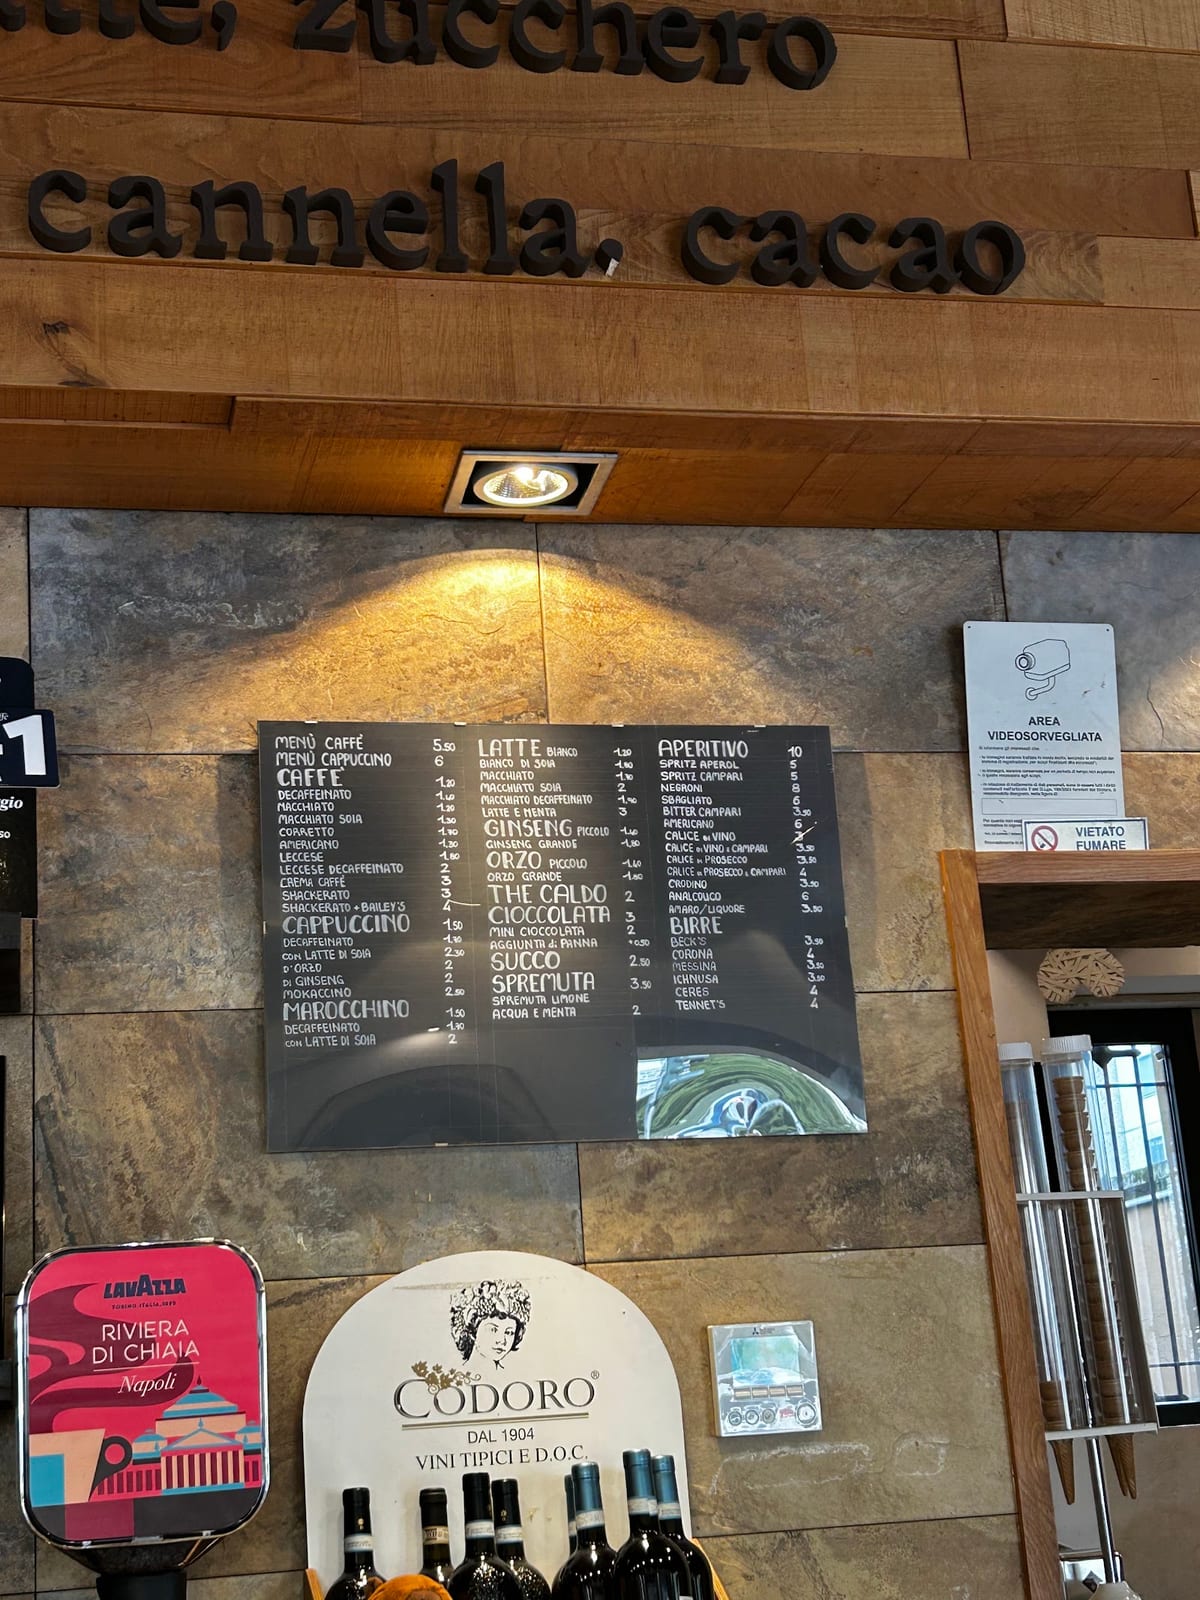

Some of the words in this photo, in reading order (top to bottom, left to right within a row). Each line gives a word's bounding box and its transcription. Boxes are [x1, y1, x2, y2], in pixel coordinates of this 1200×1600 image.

[293, 0, 838, 90] zucchero
[680, 206, 1026, 294] cacao
[1028, 716, 1061, 726] AREA
[275, 733, 316, 750] MENÙ
[987, 730, 1102, 742] VIDEOSORVEGLIATA
[478, 738, 542, 757] LATTE
[547, 747, 578, 757] BIANCO
[658, 738, 749, 759] APERITIVO
[787, 746, 803, 758] 10
[275, 751, 316, 766] MENÙ
[321, 752, 392, 767] CAPPUCCINO
[434, 755, 444, 767] 6
[479, 759, 514, 768] BIANCO
[520, 759, 530, 768] DI
[534, 759, 556, 768] SOIA
[659, 759, 697, 769] SPRITZ
[700, 760, 740, 769] APEROL
[790, 759, 797, 769] 5
[480, 771, 534, 780] MACCHIATO
[660, 771, 697, 781] SPRITZ
[700, 772, 743, 781] CAMPARI
[790, 771, 798, 781] 5
[480, 783, 535, 792] MACCHIATO
[539, 782, 562, 792] SOIA
[617, 782, 627, 792] 2
[661, 784, 703, 793] NEGRONI
[791, 783, 800, 793] 8
[278, 789, 352, 800] DECAFFEINATO
[481, 795, 531, 804] MACCHIATO
[533, 794, 593, 805] DECAFFEINATO
[661, 795, 713, 805] SBAGLIATO
[792, 795, 801, 805] 6
[277, 801, 335, 812] MACCHIATO
[482, 807, 509, 817] LATTE
[514, 808, 521, 817] E
[523, 807, 557, 817] MENTA
[618, 807, 628, 816] 3
[663, 806, 696, 816] BITTER
[698, 807, 742, 817] CAMPARI
[278, 814, 334, 824] MACCHIATO
[339, 814, 363, 824] SOIA
[663, 819, 714, 828] AMERICANO
[794, 818, 803, 828] 6
[278, 827, 335, 837] CORRETTO
[483, 818, 573, 837] GINSENG
[576, 826, 610, 837] PICCOLO
[1075, 826, 1125, 838] VIETATO
[665, 831, 700, 841] CALICE
[712, 831, 736, 841] VINO
[279, 839, 339, 850] AMERICANO
[485, 840, 532, 849] GINSENG
[538, 838, 578, 849] GRANDE
[665, 843, 694, 852] CALICE
[703, 844, 724, 853] VINO
[731, 844, 768, 853] CAMPARI
[1076, 839, 1127, 850] FUMARE
[279, 852, 324, 862] LECCESE
[486, 850, 542, 869] ORZO
[549, 858, 588, 870] PICCOLO
[666, 855, 694, 864] CALICE
[704, 855, 748, 864] PROSECCO
[279, 864, 324, 875] LECCESE
[329, 863, 404, 874] DECAFFEINATO
[440, 863, 450, 873] 2
[667, 867, 695, 876] CALICE
[703, 867, 744, 877] PROSECCO
[750, 867, 787, 876] CAMPARI
[799, 867, 807, 877] 4
[280, 877, 313, 888] CREMA
[441, 875, 452, 885] 3
[487, 872, 515, 882] ORZO
[522, 871, 562, 882] GRANDE
[668, 879, 707, 889] CRODINO
[282, 888, 350, 900] SHACKERATO
[441, 888, 452, 898] 3
[487, 884, 533, 903] THE
[539, 884, 607, 903] CALDO
[624, 891, 635, 902] 2
[801, 891, 809, 901] 6
[282, 903, 351, 913] SHACKERATO
[442, 899, 451, 912] 4
[488, 906, 611, 924] CIOCCOLATA
[625, 911, 636, 922] 3
[282, 914, 410, 934] CAPPUCCINO
[670, 916, 723, 935] BIRRE
[489, 927, 515, 937] MINI
[520, 926, 585, 936] CIOCCOLATA
[627, 925, 636, 935] 2
[283, 937, 354, 948] DECAFFEINATO
[490, 939, 546, 950] AGGIUNTA
[560, 938, 598, 948] PANNA
[670, 937, 707, 948] BECK'S
[305, 949, 335, 960] LATTE
[351, 949, 372, 959] SOIA
[672, 948, 713, 960] CORONA
[806, 947, 815, 959] 4
[444, 960, 454, 970] 2
[491, 951, 561, 971] SUCCO
[672, 961, 717, 972] MESSINA
[295, 975, 344, 986] GINSENG
[444, 972, 454, 983] 2
[492, 972, 595, 993] SPREMUTA
[673, 974, 719, 984] ICHNUSA
[283, 987, 351, 999] MOKACCINO
[675, 986, 709, 997] CERES
[809, 985, 818, 995] 4
[492, 994, 547, 1006] SPREMUTA
[551, 993, 590, 1004] LIMONE
[810, 998, 819, 1009] 4
[282, 1000, 409, 1021] MAROCCHINO
[492, 1007, 529, 1020] ACQUA
[533, 1007, 540, 1018] E
[542, 1006, 577, 1018] MENTA
[632, 1005, 641, 1016] 2
[285, 1022, 360, 1035] DECAFFEINATO
[305, 1035, 338, 1046] LATTE
[354, 1034, 376, 1045] SOIA
[448, 1033, 457, 1044] 2
[103, 1274, 187, 1299] LAVAZZA
[101, 1318, 190, 1342] RIVIERA
[92, 1345, 114, 1364] DI
[124, 1340, 200, 1363] CHIAIA
[117, 1373, 176, 1397] Napoli
[467, 1429, 497, 1444] DAL
[501, 1427, 535, 1442] 1904
[415, 1454, 456, 1470] VINI
[459, 1449, 514, 1467] TIPICI
[519, 1448, 531, 1464] E
[535, 1445, 589, 1462] D.O.C.
